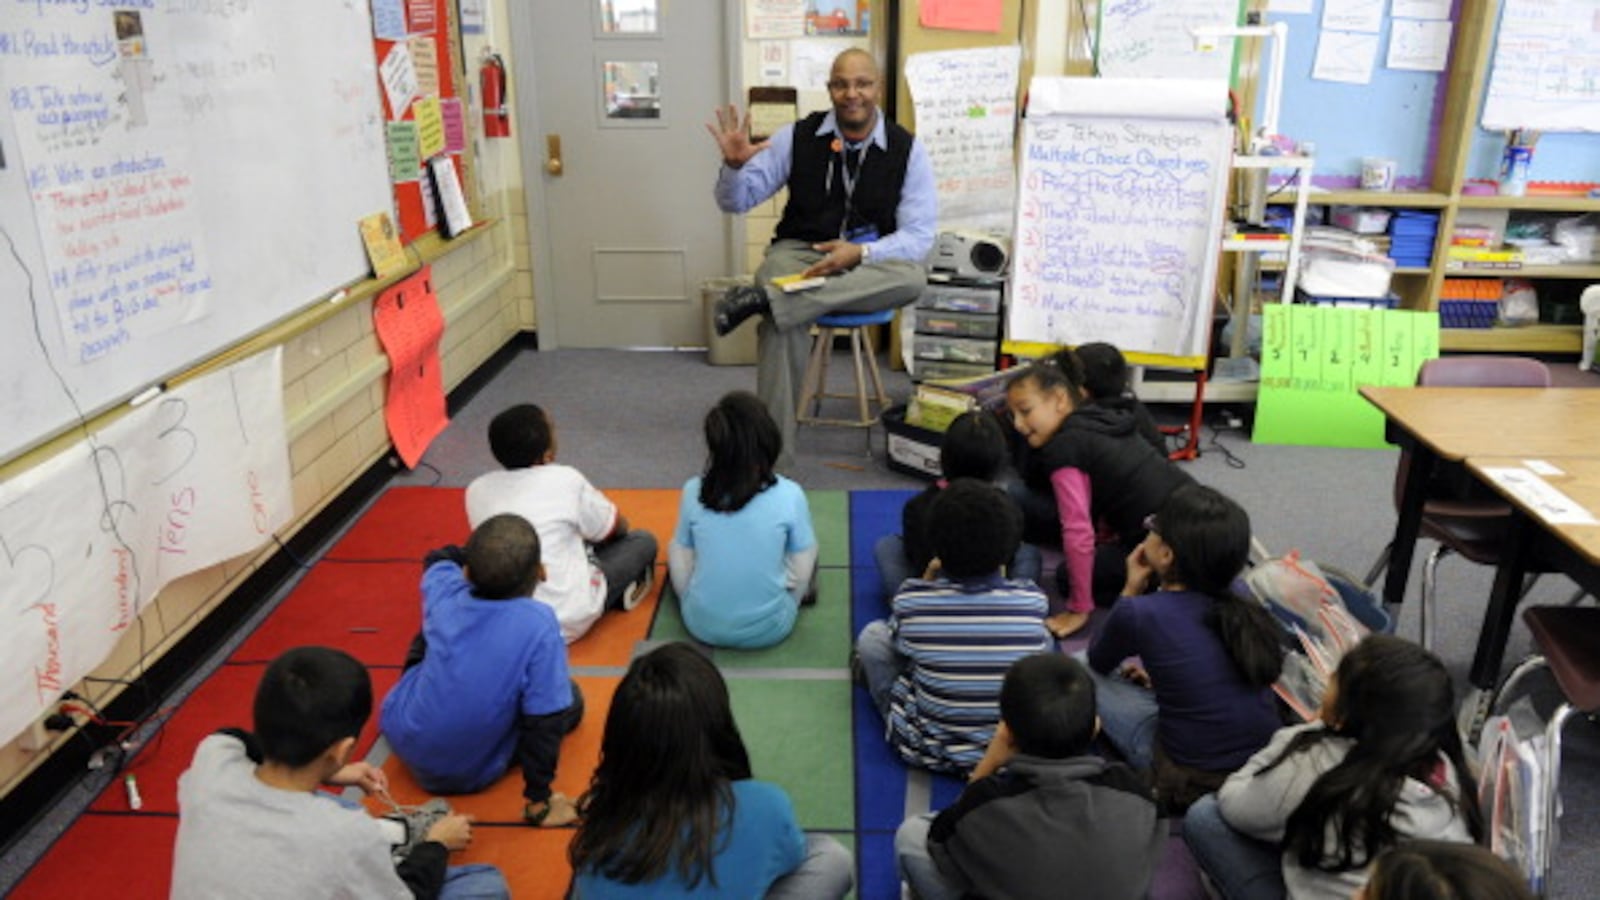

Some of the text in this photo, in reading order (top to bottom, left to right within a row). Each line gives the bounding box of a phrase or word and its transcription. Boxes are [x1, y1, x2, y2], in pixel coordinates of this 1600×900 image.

[23, 28, 59, 58] Read
[1028, 120, 1060, 142] Test
[1066, 122, 1119, 149] Taking
[1028, 144, 1081, 165] Multiple
[1083, 147, 1132, 166] Choice
[1041, 293, 1079, 312] Mark
[151, 398, 197, 486] 3
[160, 487, 196, 555] Tens
[35, 602, 61, 704] Thousand
